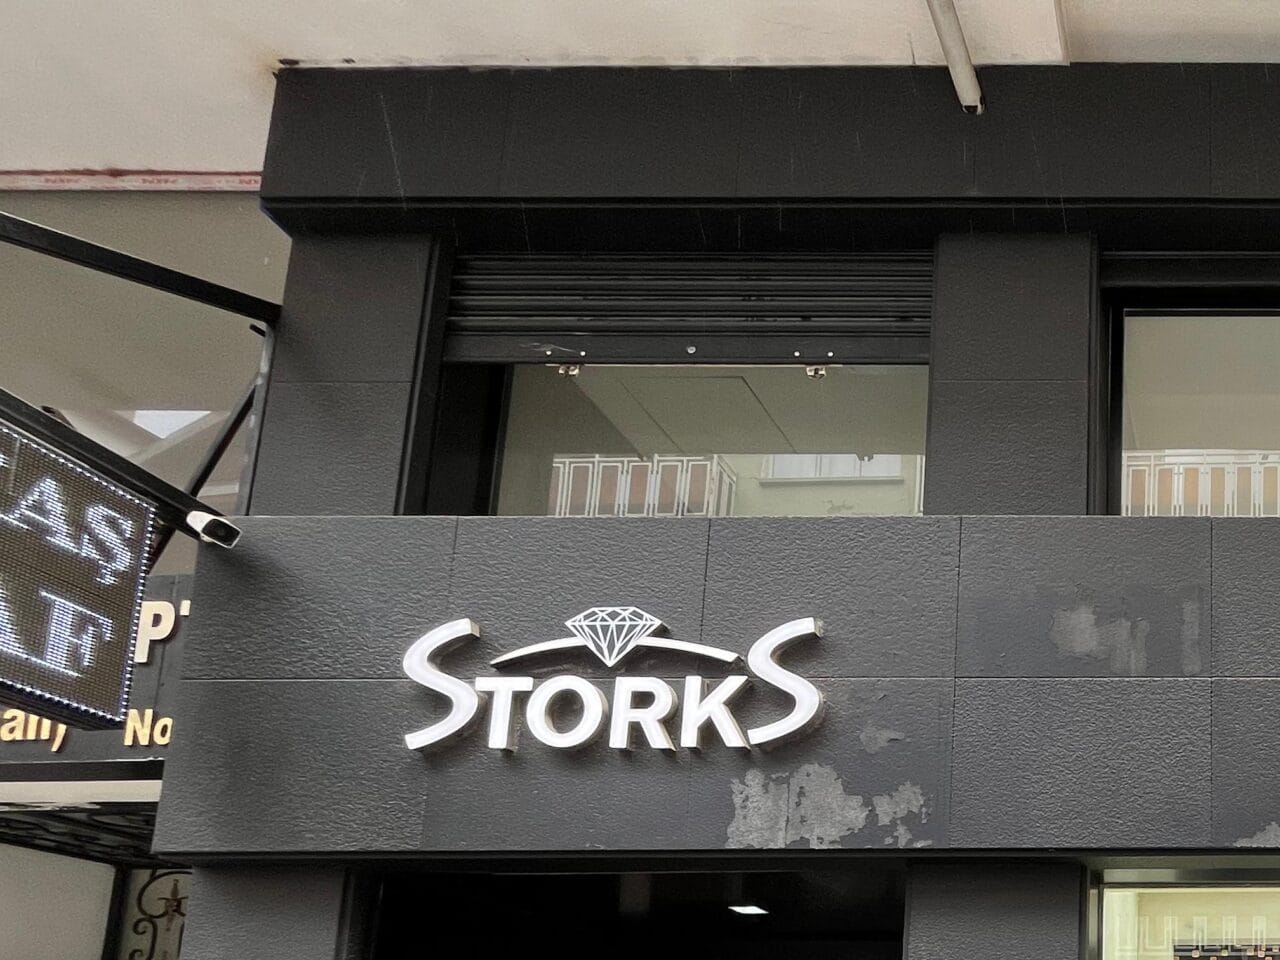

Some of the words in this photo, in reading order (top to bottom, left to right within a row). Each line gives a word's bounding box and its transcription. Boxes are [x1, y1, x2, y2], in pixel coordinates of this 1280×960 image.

[0, 452, 134, 585] AŞ
[134, 600, 191, 663] P
[403, 617, 822, 751] STORKS
